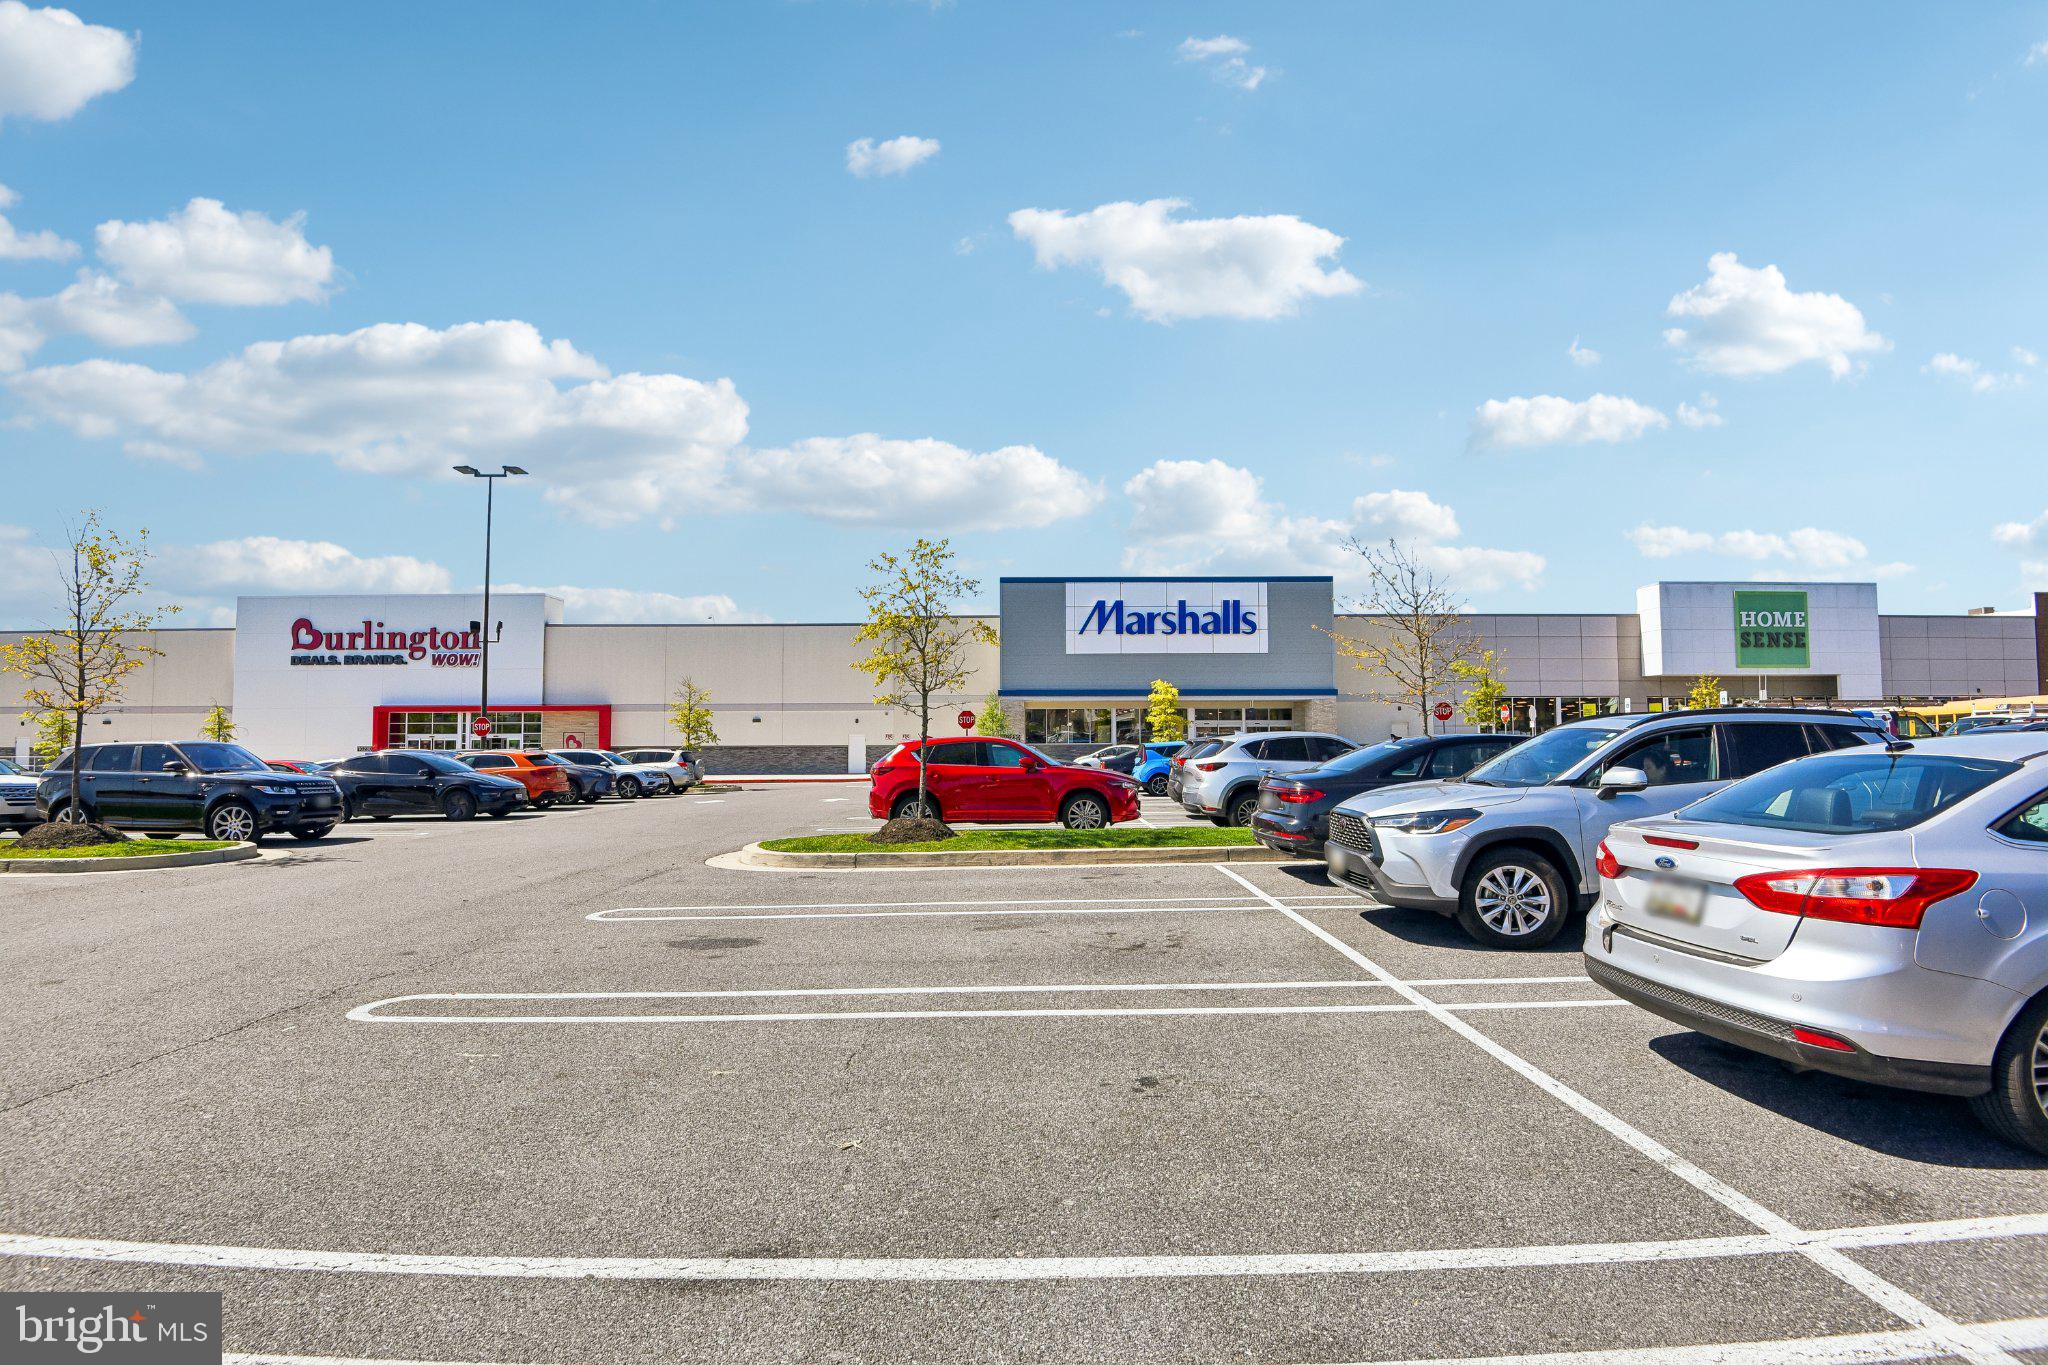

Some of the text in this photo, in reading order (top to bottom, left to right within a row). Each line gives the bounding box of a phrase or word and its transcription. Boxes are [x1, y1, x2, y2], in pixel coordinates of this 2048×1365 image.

[1078, 599, 1258, 635] Marshalls
[1740, 611, 1806, 628] HOME
[291, 617, 482, 660] Burlington
[1740, 631, 1807, 649] SENSE
[290, 652, 482, 667] DEALS. BRANDS. WOW!
[1434, 707, 1453, 716] STOP
[474, 723, 490, 731] STOP
[958, 716, 975, 724] STOP
